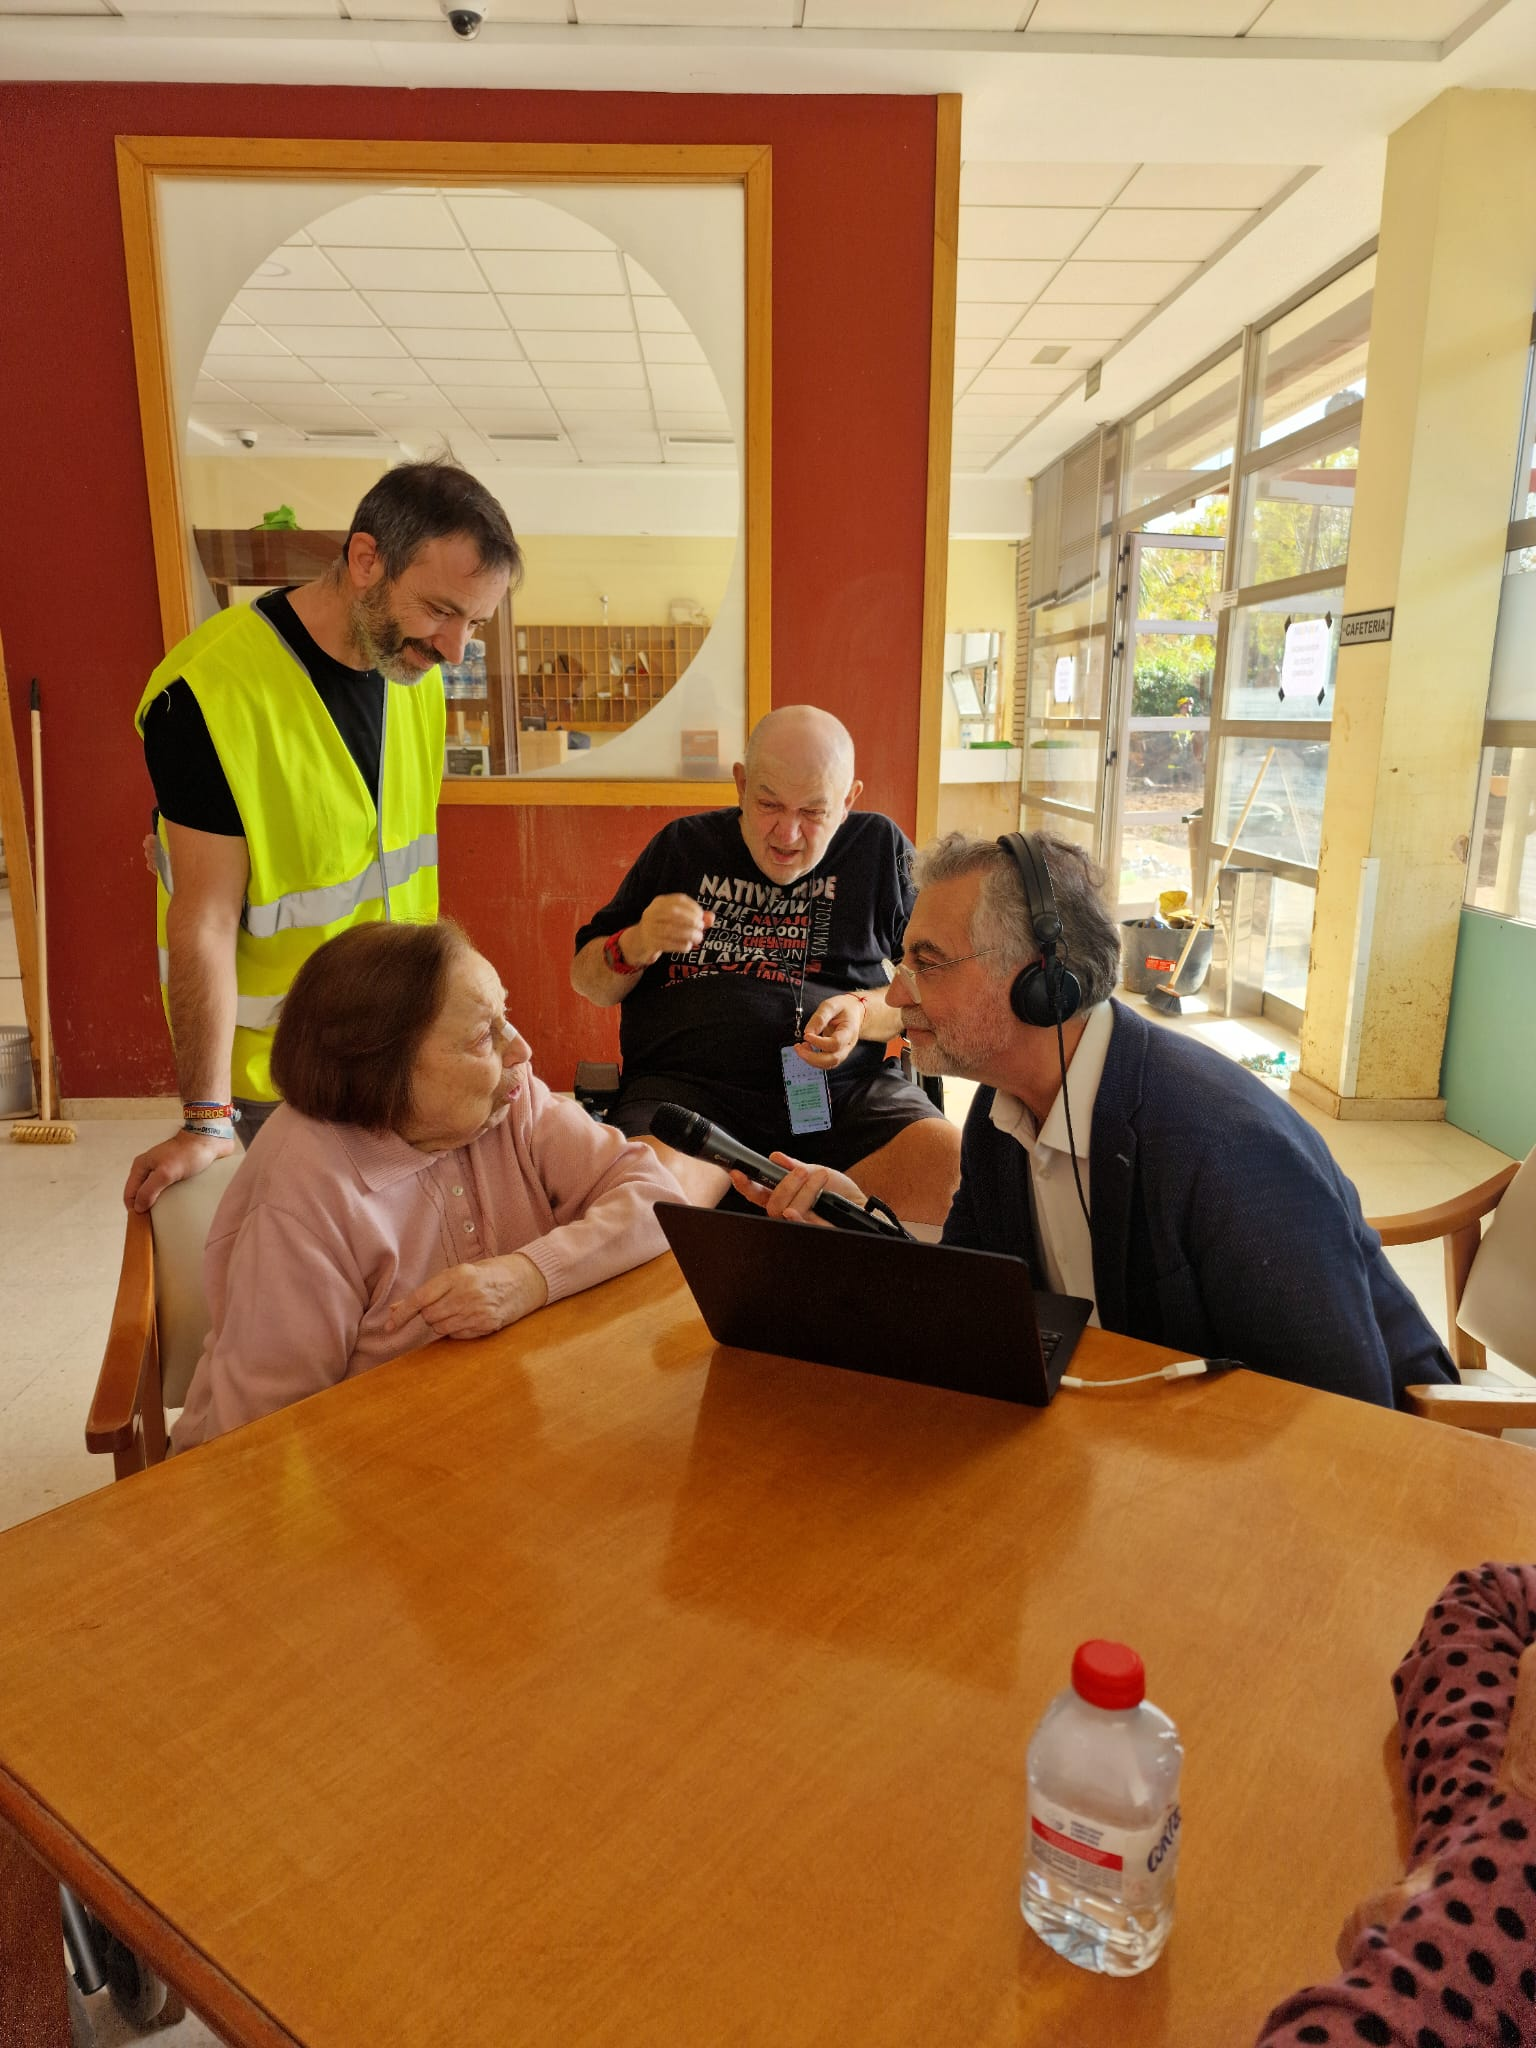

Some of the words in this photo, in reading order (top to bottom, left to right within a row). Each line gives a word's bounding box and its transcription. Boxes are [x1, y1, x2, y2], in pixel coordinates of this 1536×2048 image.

[1345, 619, 1385, 636] CAFETERIA
[699, 873, 784, 908] NATIVE
[751, 914, 812, 927] NAVAJO
[811, 900, 832, 956] SEMINOLE
[707, 929, 742, 943] HOPI
[711, 920, 811, 939] BLACKFOOT
[702, 940, 765, 955] MOHAWK
